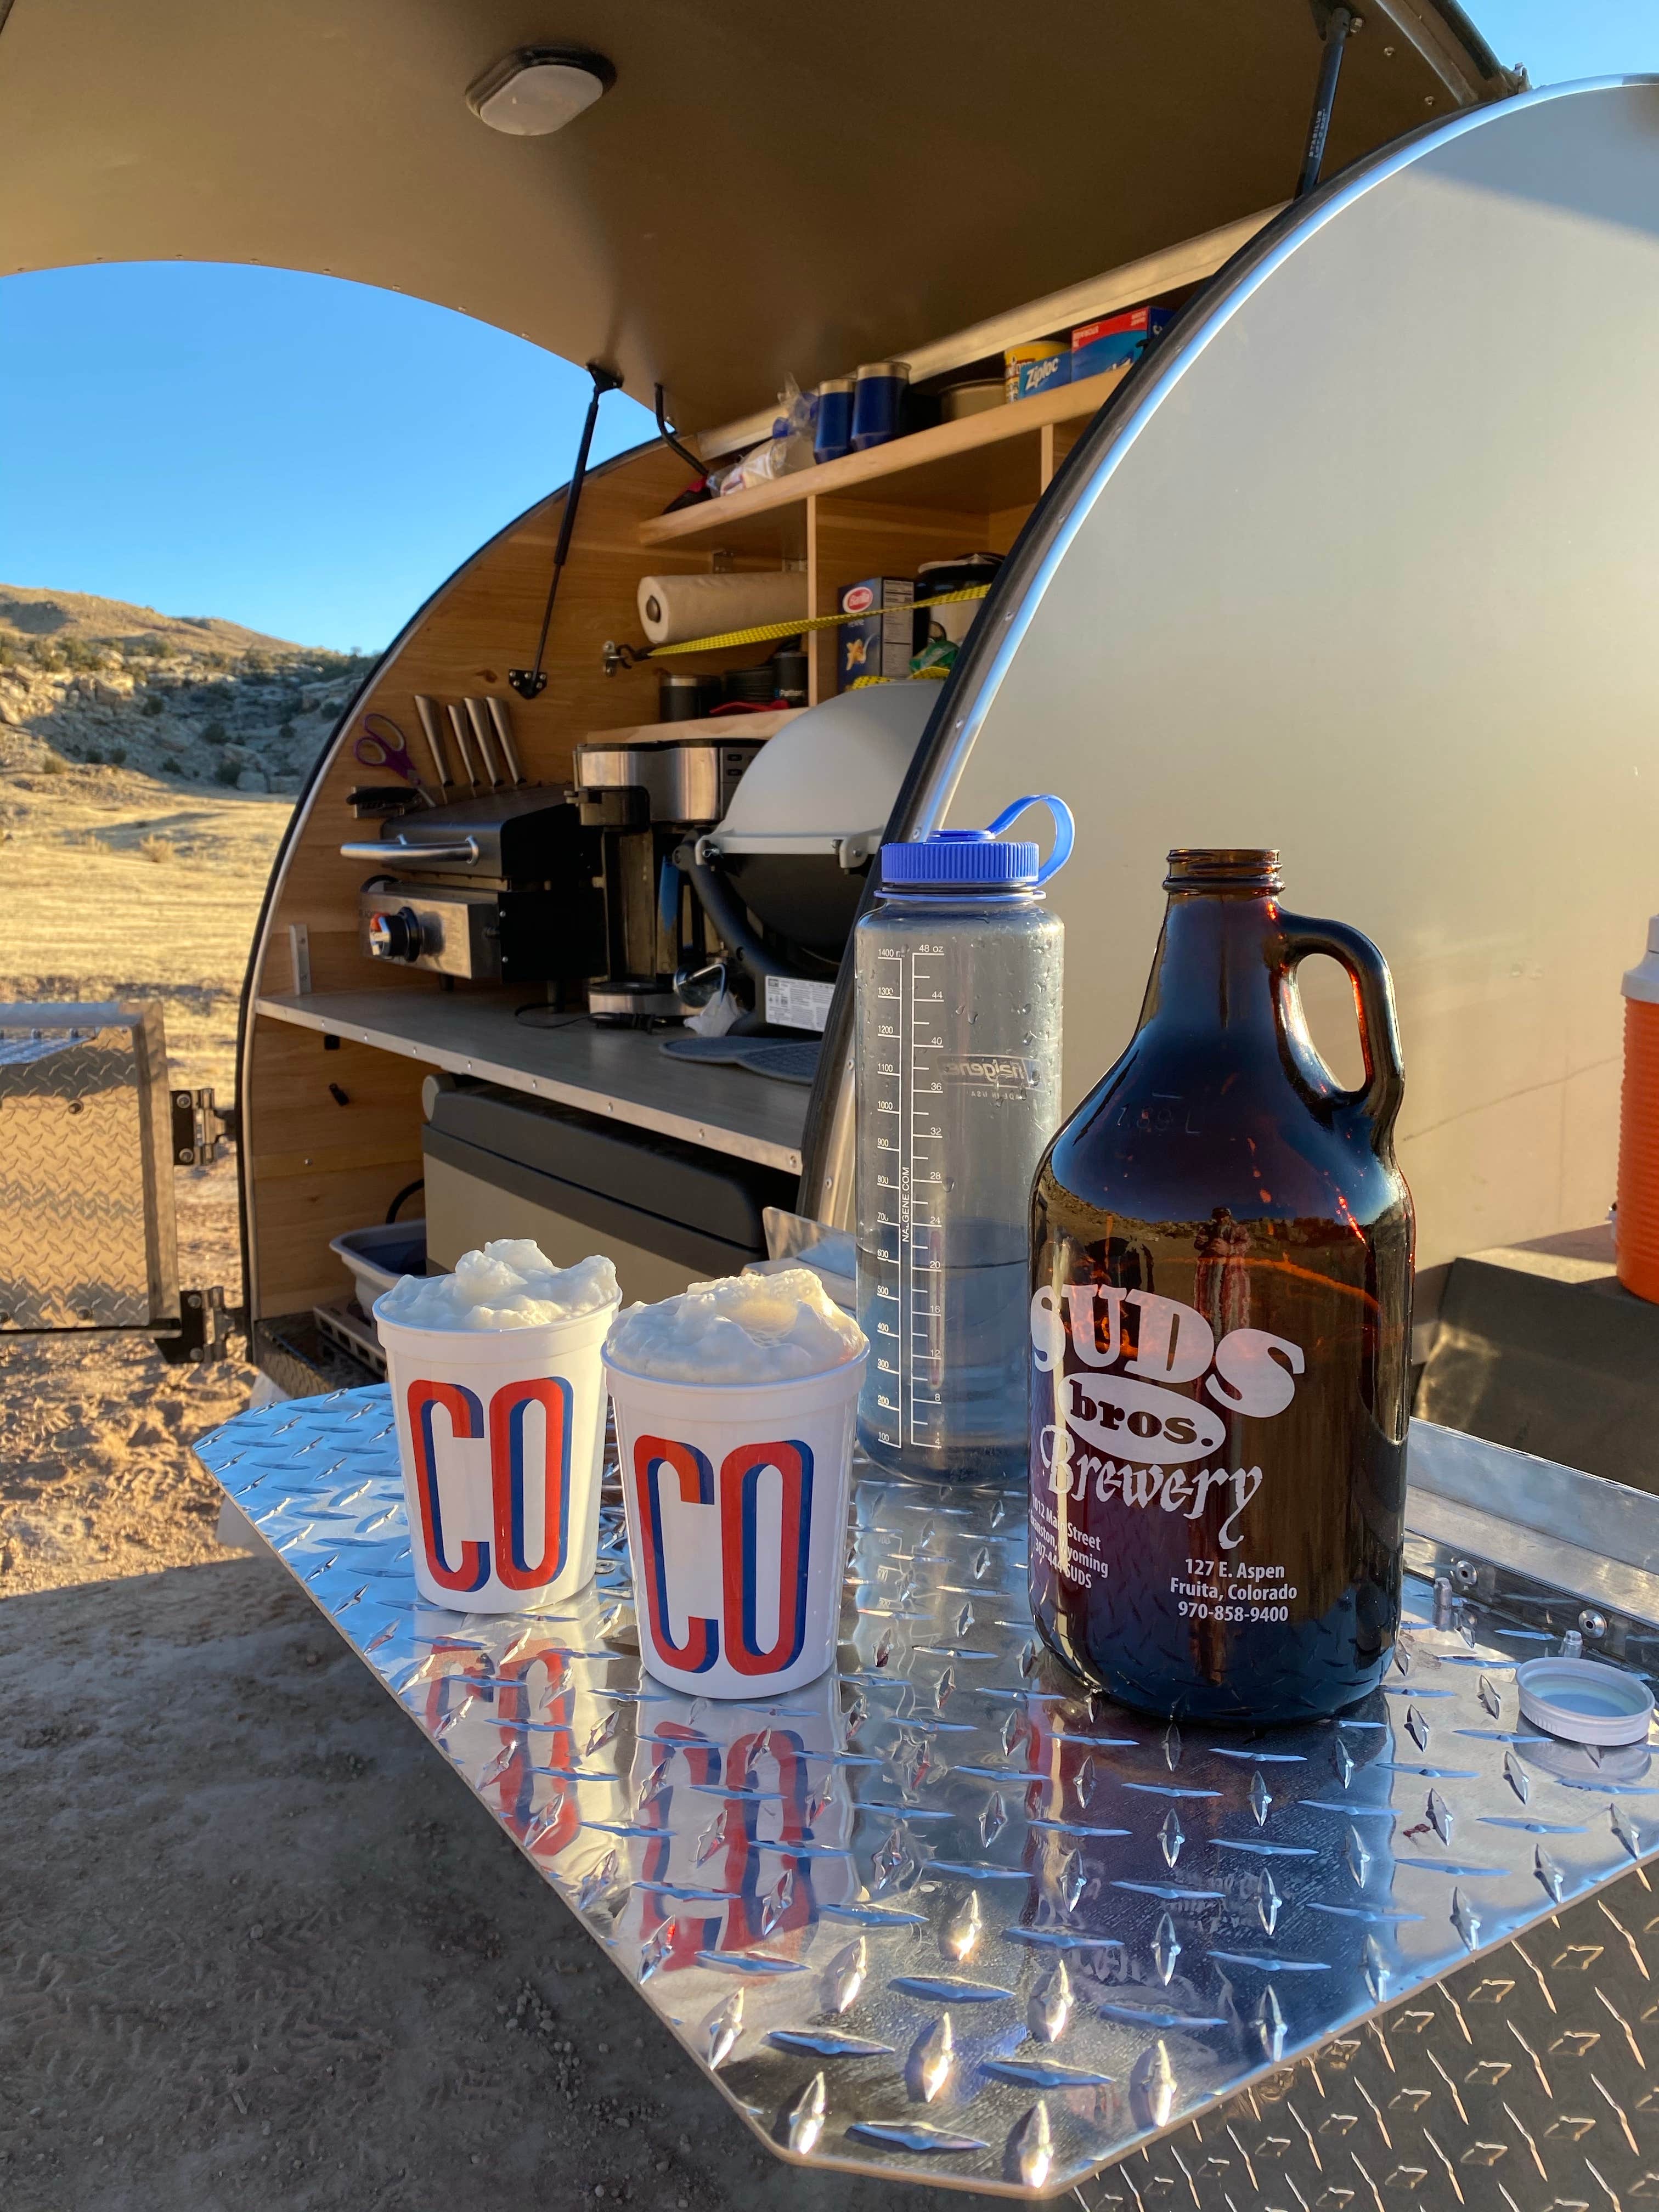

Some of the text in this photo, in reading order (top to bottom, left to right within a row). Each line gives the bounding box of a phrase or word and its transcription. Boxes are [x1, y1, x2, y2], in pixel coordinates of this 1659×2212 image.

[1025, 358, 1059, 390] Ziploc
[878, 948, 894, 957] 1400
[919, 944, 929, 953] 48
[878, 987, 894, 996] 1300
[932, 991, 943, 999] 44
[878, 1025, 894, 1035] 1200
[931, 1037, 943, 1045] 40
[878, 1063, 893, 1072] 1100
[931, 1082, 942, 1091] 36
[878, 1101, 893, 1110] 1000
[930, 1127, 941, 1136] 32
[877, 1138, 889, 1147] 900
[877, 1175, 889, 1184] 800
[930, 1172, 941, 1180] 28
[930, 1216, 941, 1224] 24
[877, 1249, 889, 1259] 600
[930, 1261, 940, 1269] 20
[877, 1285, 889, 1295] 500
[877, 1322, 889, 1332] 400
[930, 1349, 940, 1357] 12
[1030, 1284, 1305, 1418] SUDS
[878, 1358, 889, 1369] 300
[878, 1395, 889, 1406] 200
[1069, 1379, 1214, 1447] bros.
[878, 1431, 889, 1442] 100
[407, 1376, 574, 1592] CO
[1040, 1424, 1262, 1550] Brewery
[1032, 1493, 1101, 1551] 1012 Main Street
[634, 1435, 814, 1676] CO
[1058, 1537, 1109, 1578] Wyoming
[1185, 1558, 1285, 1583] 127 E. Aspen
[1170, 1577, 1297, 1601] Fruita, Colorado
[1178, 1601, 1289, 1622] 970-858-9400
